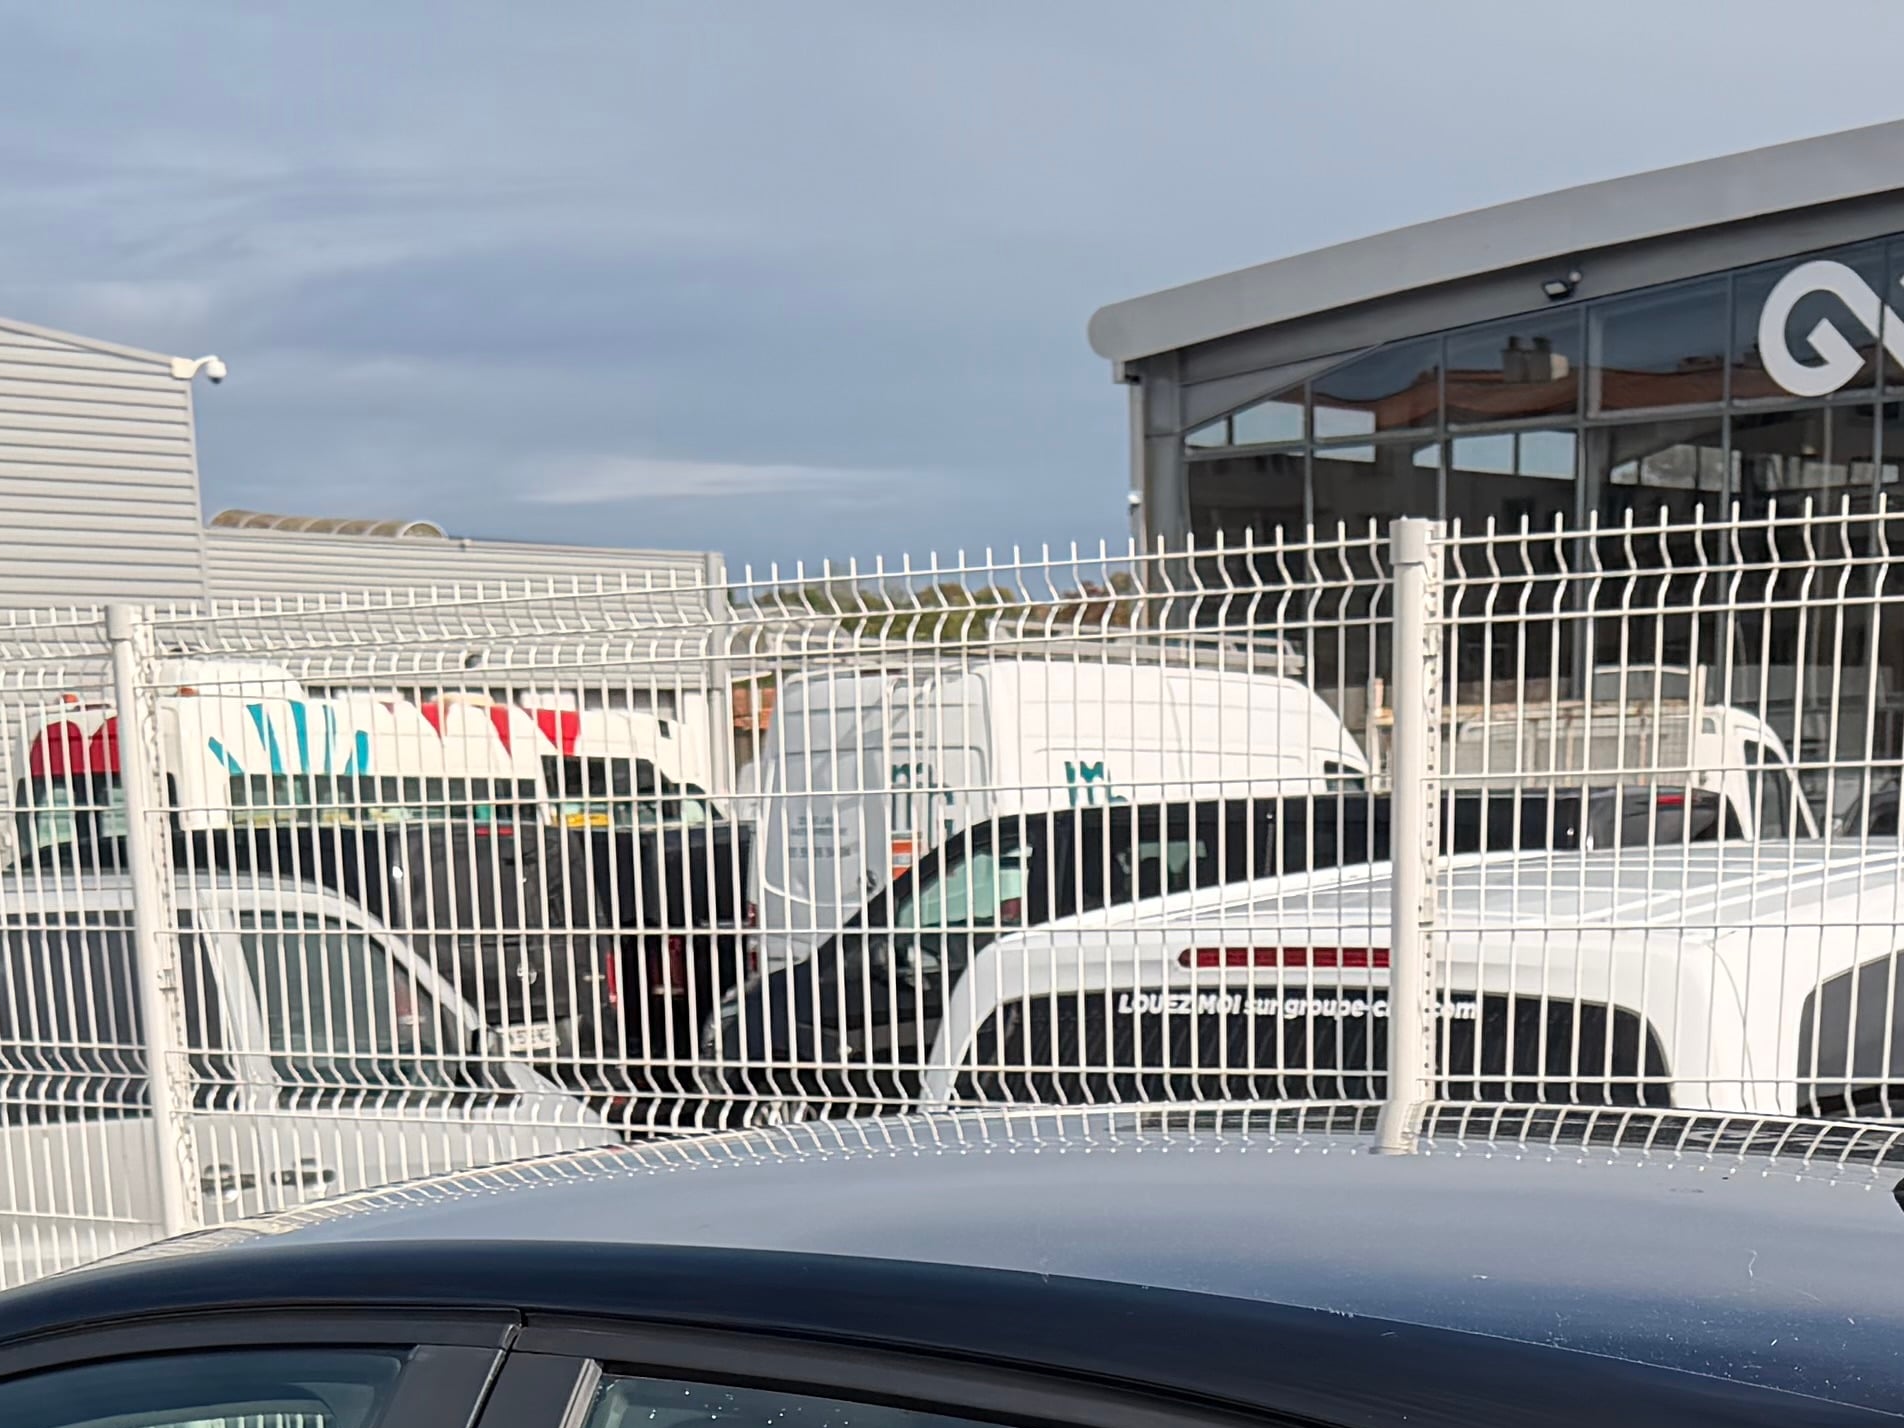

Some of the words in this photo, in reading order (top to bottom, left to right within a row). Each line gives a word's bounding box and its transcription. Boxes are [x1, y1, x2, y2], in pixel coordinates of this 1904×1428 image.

[1118, 993, 1192, 1015] LOUEZ
[1197, 994, 1242, 1015] MOI
[1243, 998, 1279, 1016] sur
